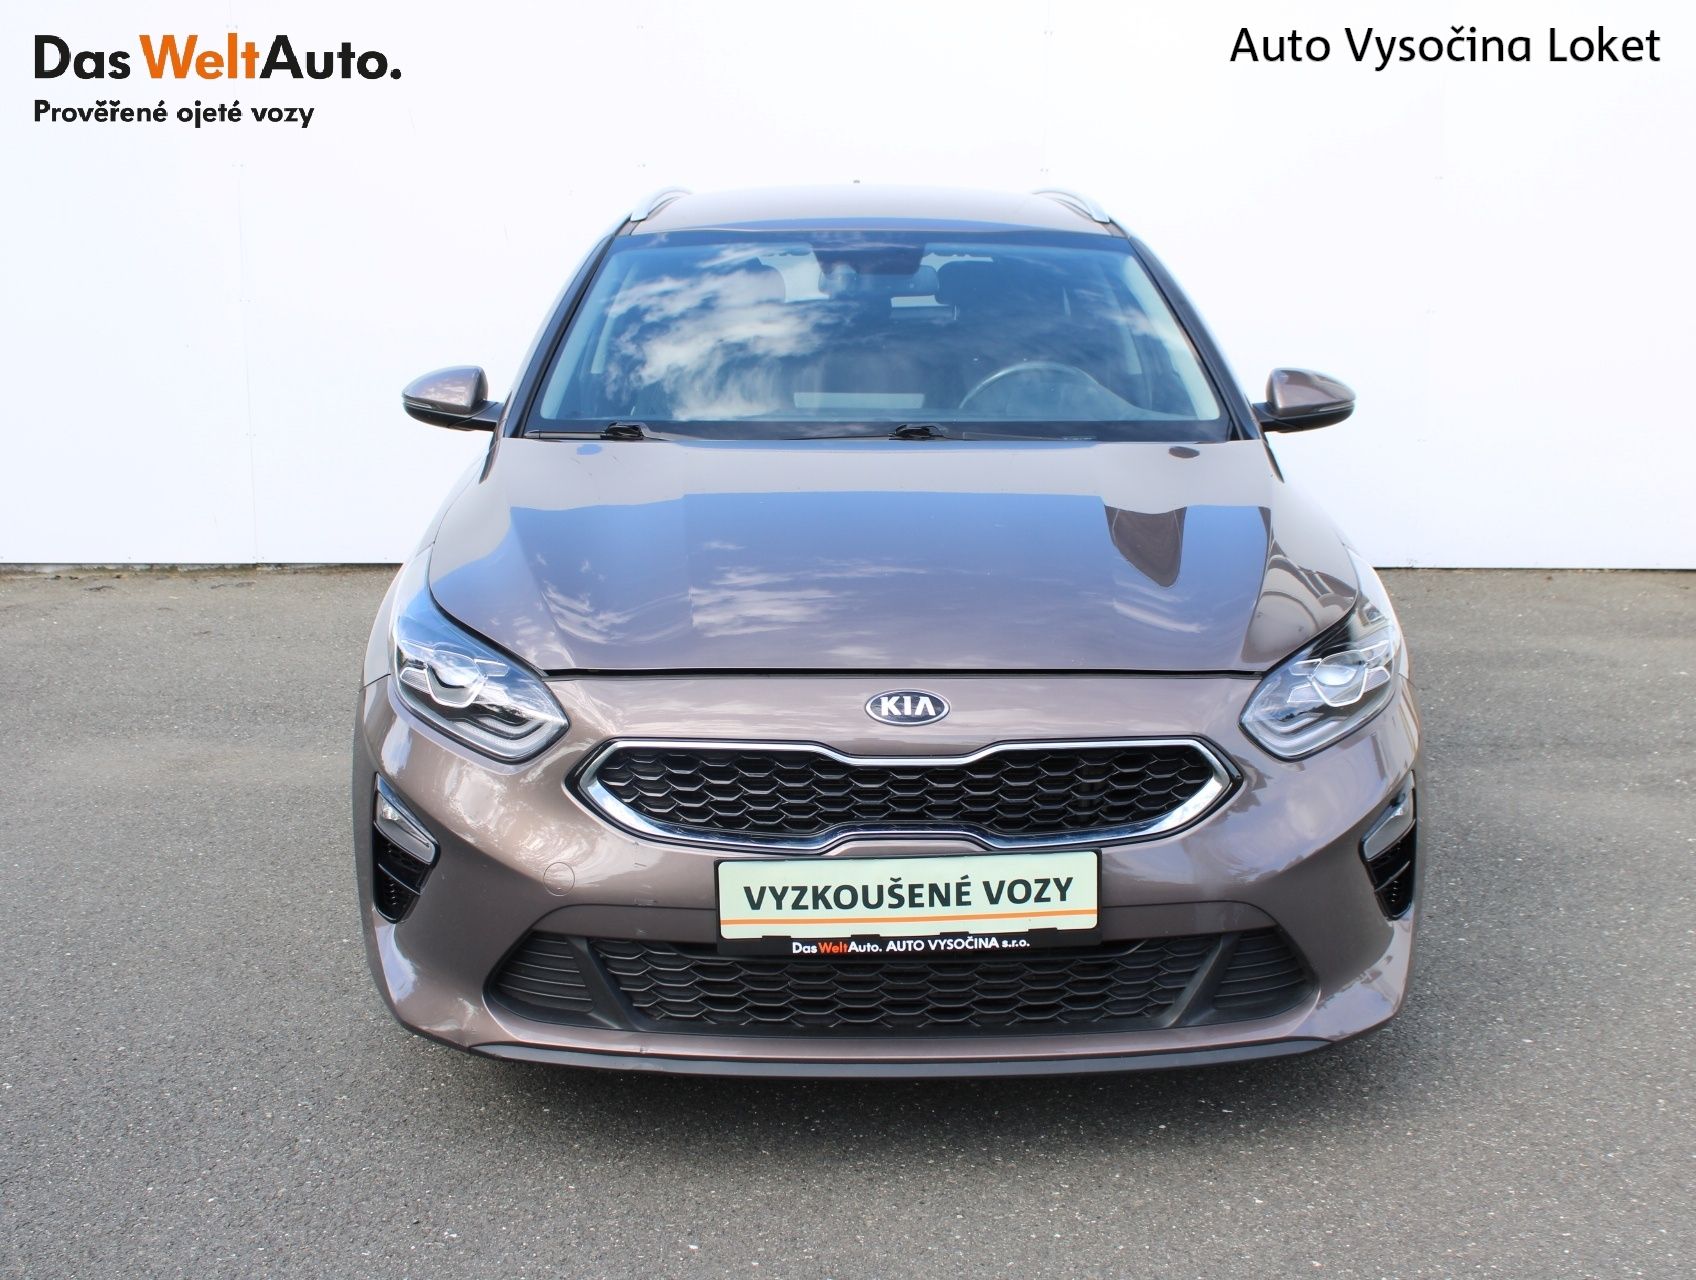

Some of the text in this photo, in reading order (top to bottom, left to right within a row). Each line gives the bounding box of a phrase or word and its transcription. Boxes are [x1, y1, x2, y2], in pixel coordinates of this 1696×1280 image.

[880, 695, 936, 716] KIA
[743, 874, 1074, 911] VYZKOUŠENÉ VOZY
[886, 939, 925, 952] AUTO
[928, 935, 1000, 952] VYSOČINA
[1001, 938, 1031, 949] s.r.o.
